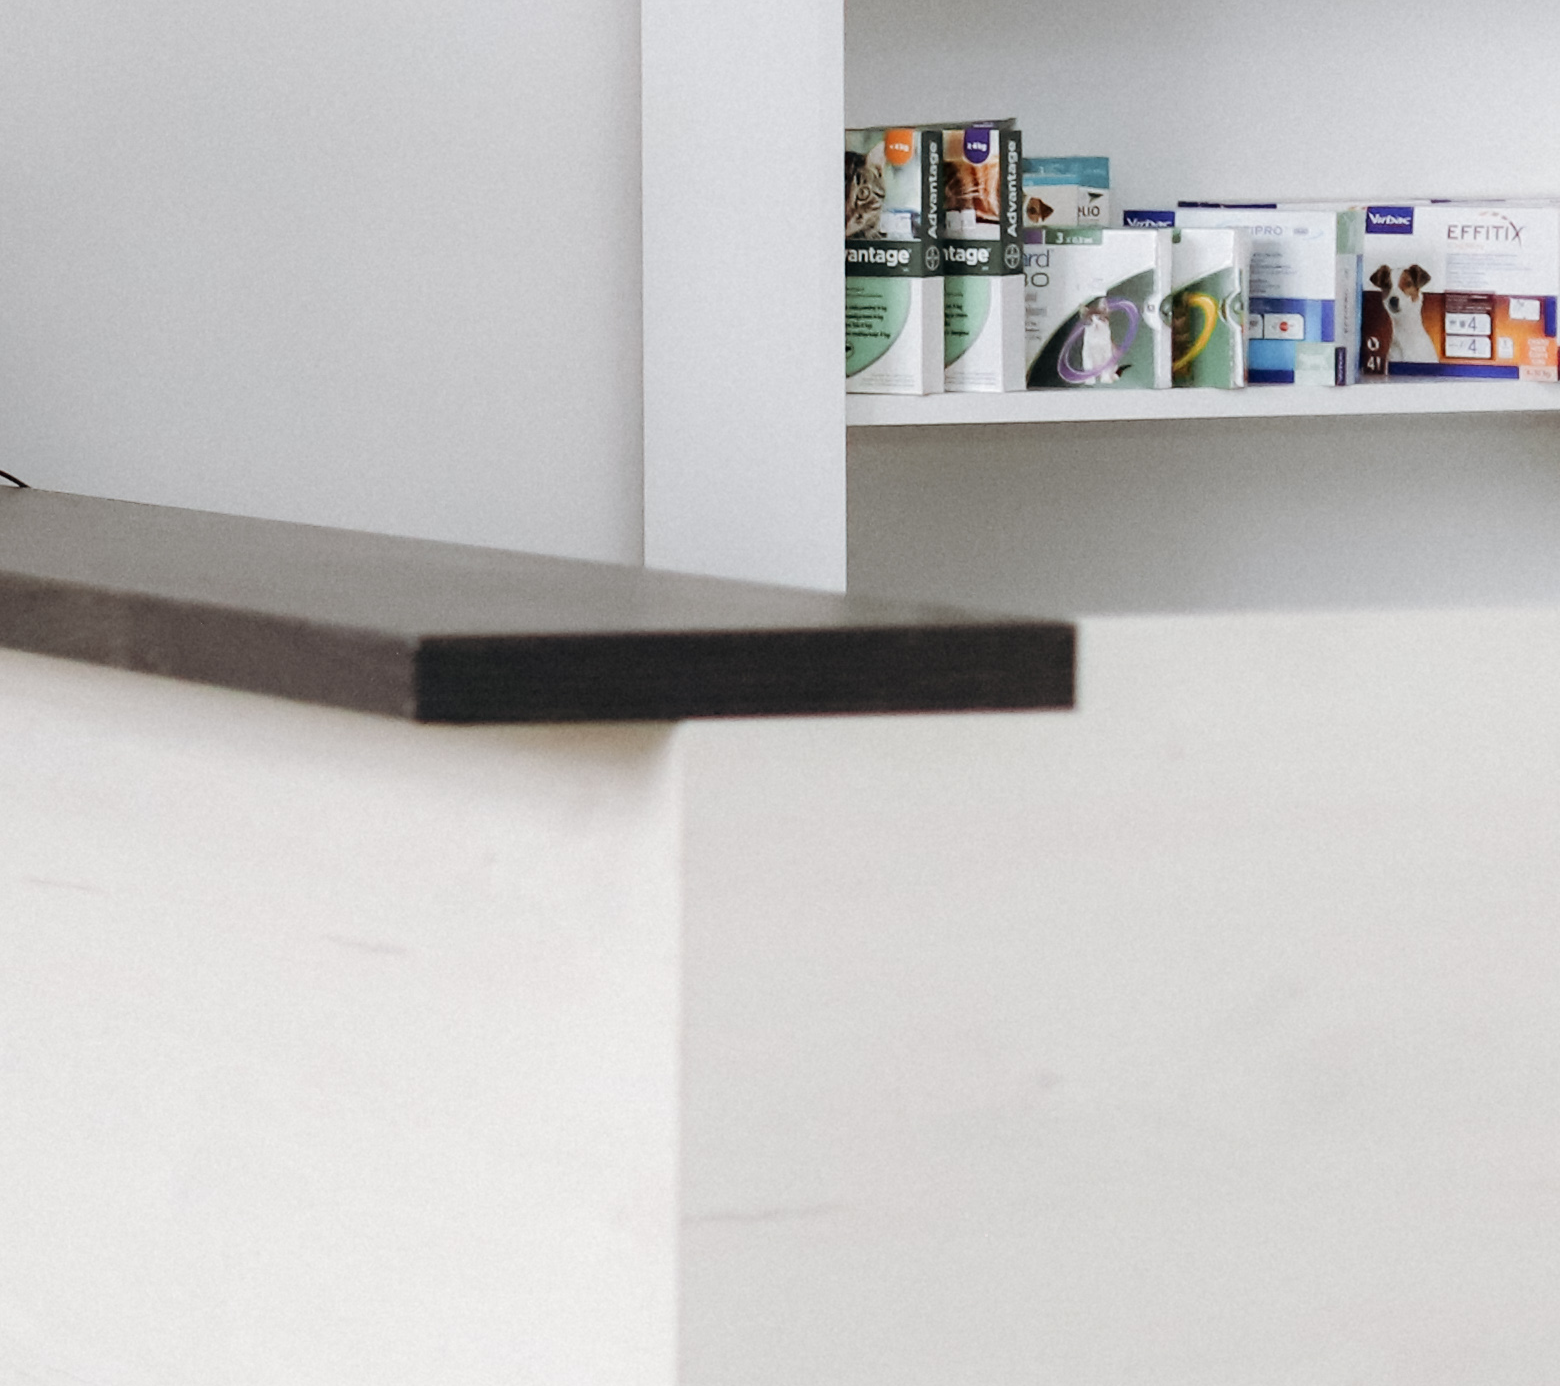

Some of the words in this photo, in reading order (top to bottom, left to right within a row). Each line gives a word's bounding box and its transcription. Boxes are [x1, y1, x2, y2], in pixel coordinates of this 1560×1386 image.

[927, 140, 938, 239] Advantage
[1007, 140, 1017, 237] Advantage
[1368, 213, 1411, 226] Virbac
[1447, 225, 1522, 245] EFFITIX
[850, 247, 910, 266] antage
